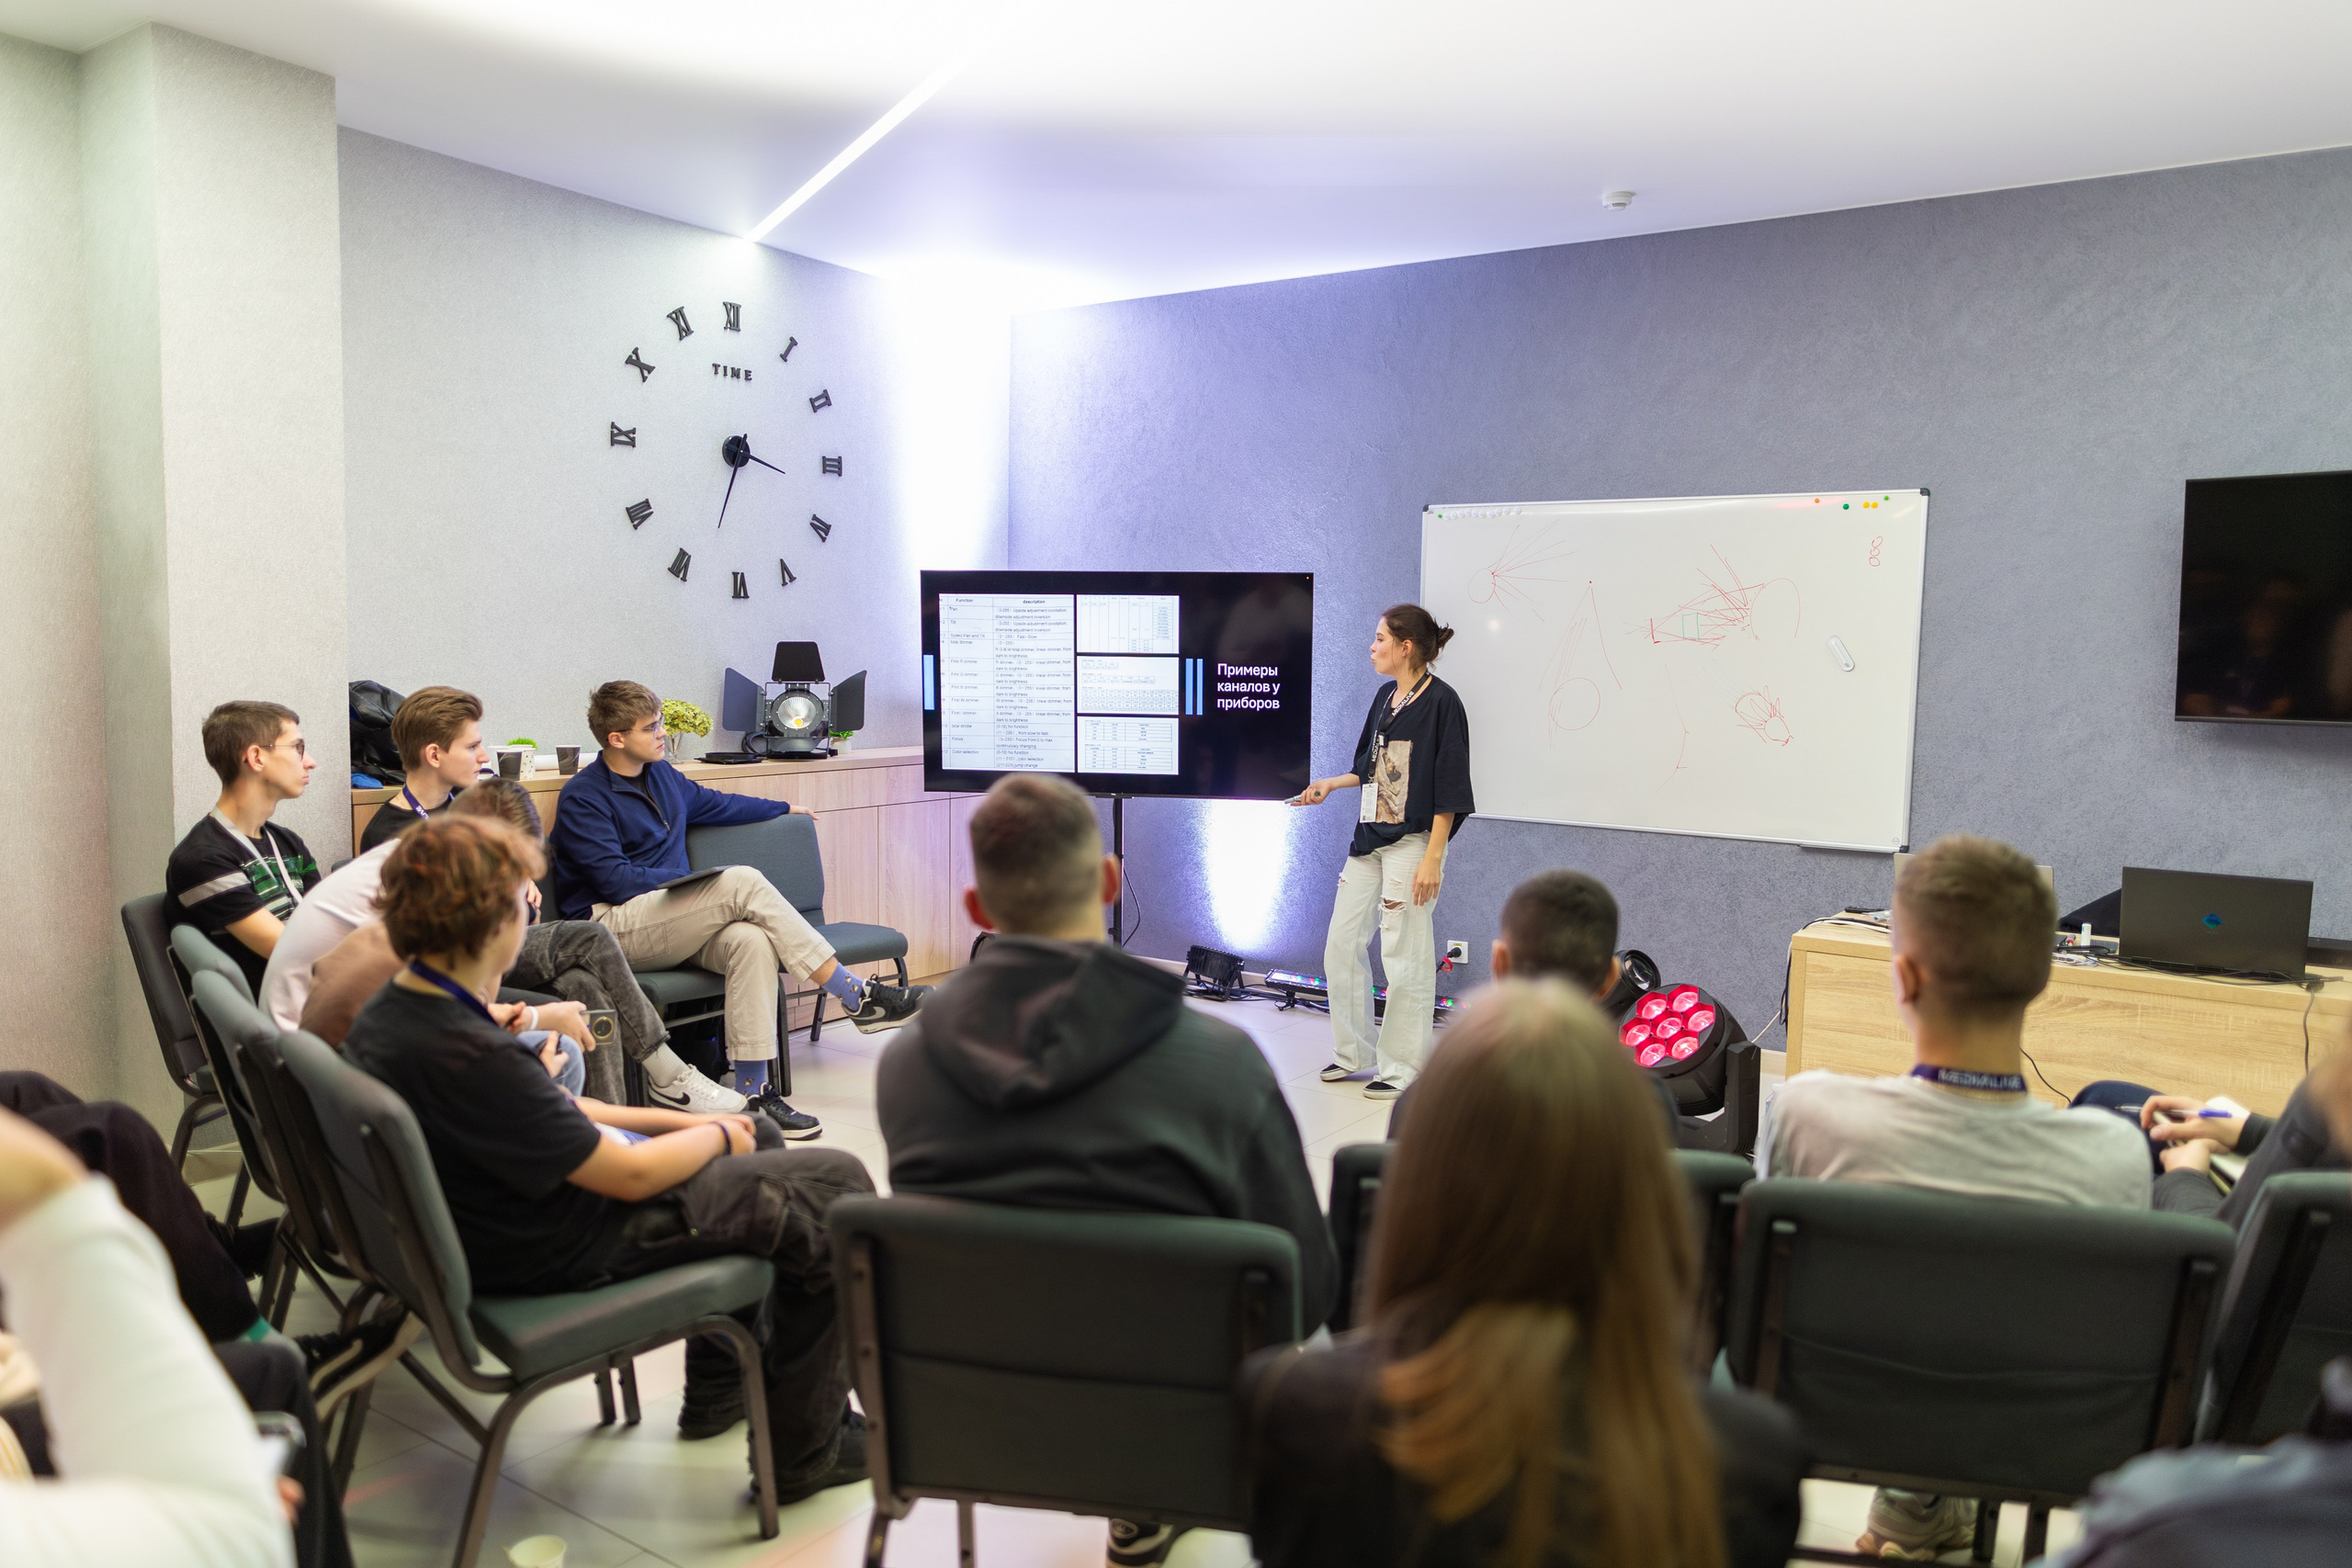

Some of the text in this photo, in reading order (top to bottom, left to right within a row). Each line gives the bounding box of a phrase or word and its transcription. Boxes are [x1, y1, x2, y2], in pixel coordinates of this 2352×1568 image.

[712, 363, 752, 381] TIME
[1217, 663, 1278, 678] Примеры
[1217, 682, 1281, 694] каналов у
[1217, 696, 1281, 711] приборов
[1392, 691, 1414, 716] MEDIALIVE
[1939, 1068, 2021, 1088] MEDIALIVE
